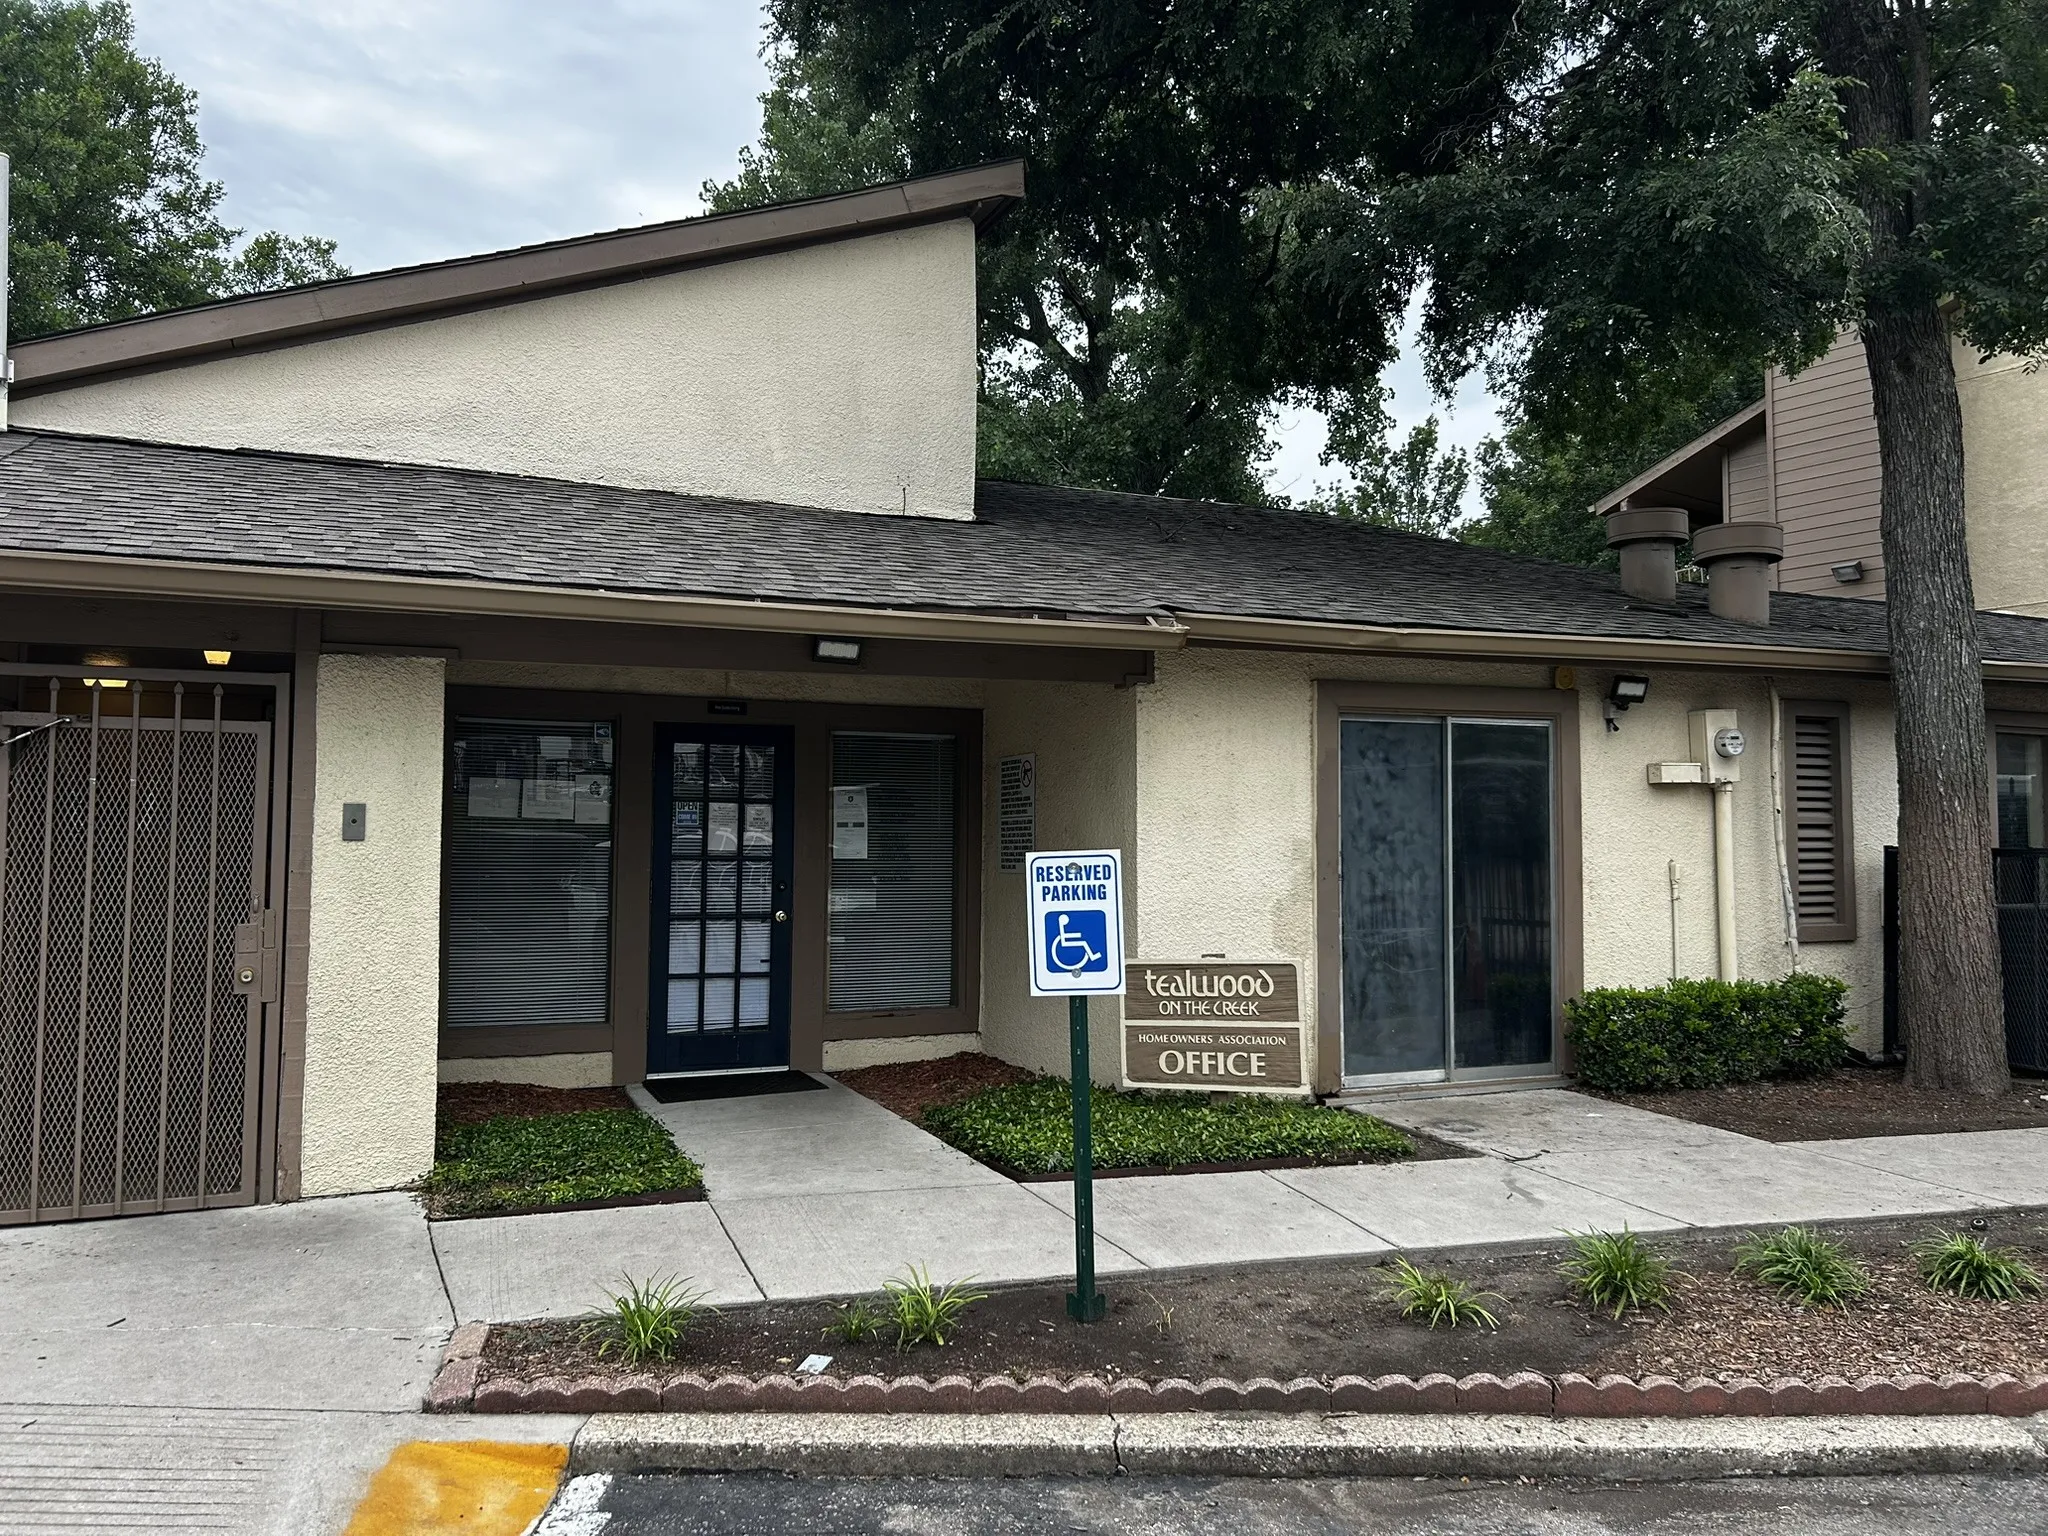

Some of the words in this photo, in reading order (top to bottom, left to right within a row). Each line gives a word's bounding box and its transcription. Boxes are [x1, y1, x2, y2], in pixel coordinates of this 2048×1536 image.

[1036, 864, 1111, 882] RESERVED
[1042, 884, 1107, 901] PARKING
[1159, 1001, 1181, 1015] ON
[1184, 1001, 1211, 1015] THE
[1213, 1001, 1260, 1016] CREEK
[1219, 1035, 1287, 1045] ASSOCIATION
[1158, 1050, 1266, 1077] OFFICE
